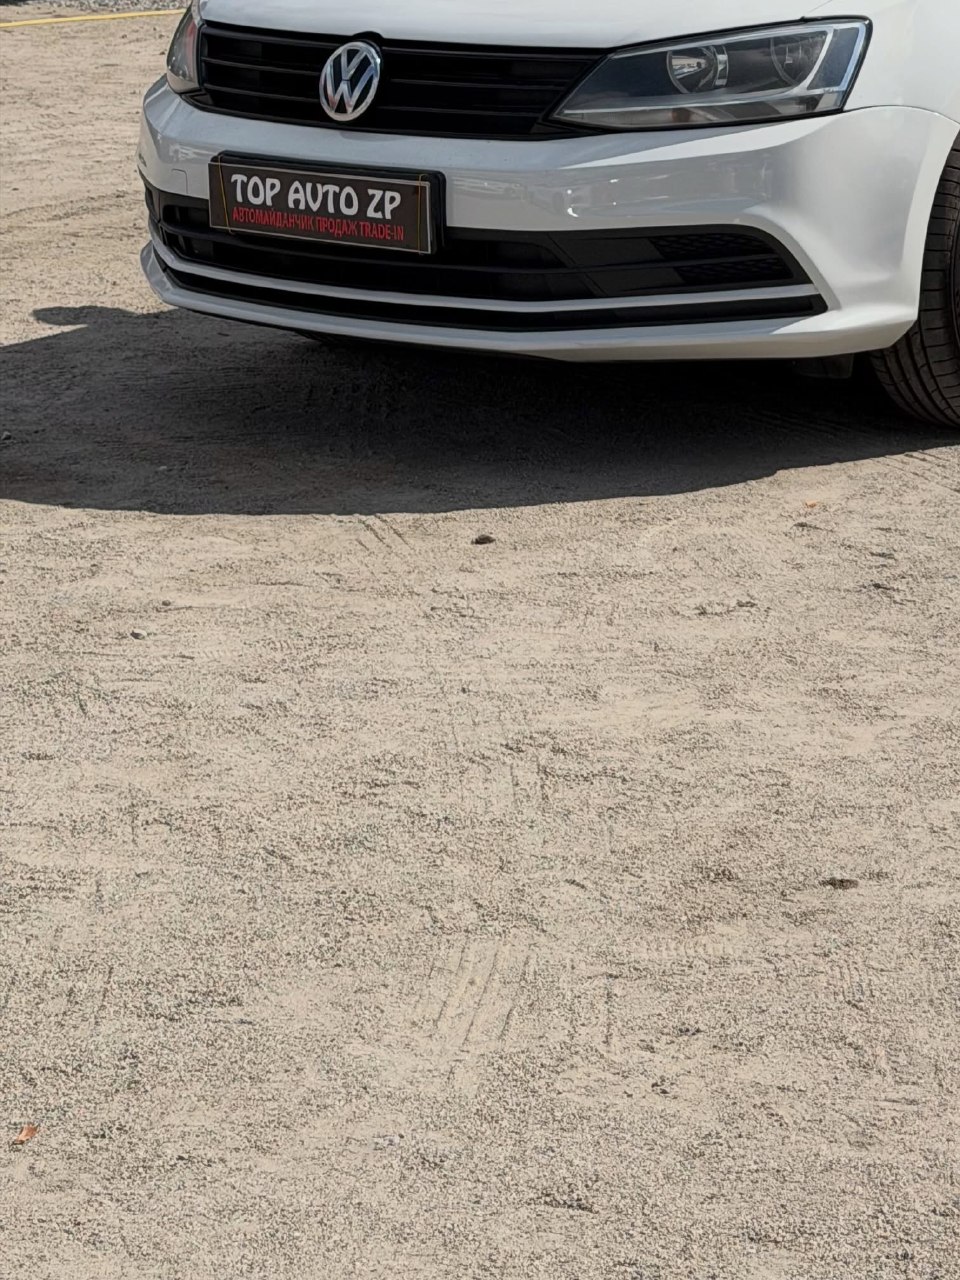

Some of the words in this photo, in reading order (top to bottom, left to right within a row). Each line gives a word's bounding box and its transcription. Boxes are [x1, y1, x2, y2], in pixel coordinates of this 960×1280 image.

[230, 173, 282, 207] TOP
[366, 188, 402, 220] ZP
[232, 206, 314, 231] АВТОМАЙДАНЧИК
[316, 216, 358, 237] ПРОДАЖ
[359, 221, 404, 241] TRADE-IN
